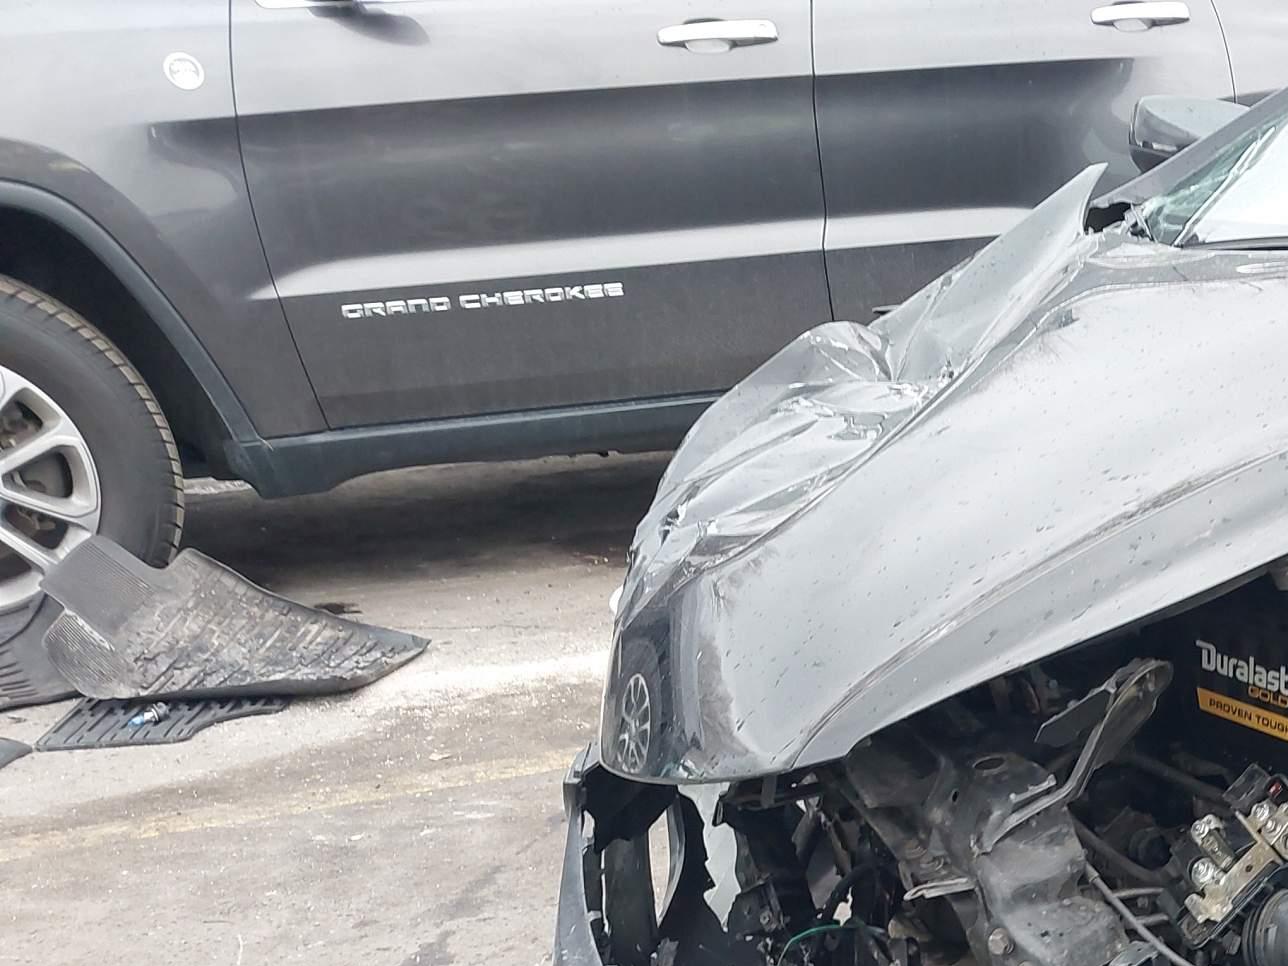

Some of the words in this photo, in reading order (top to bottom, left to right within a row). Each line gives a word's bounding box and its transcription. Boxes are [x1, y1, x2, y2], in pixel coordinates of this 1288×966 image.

[341, 296, 451, 319] GRAND
[458, 281, 626, 309] CHEROKEE
[1208, 697, 1253, 721] PROVEN
